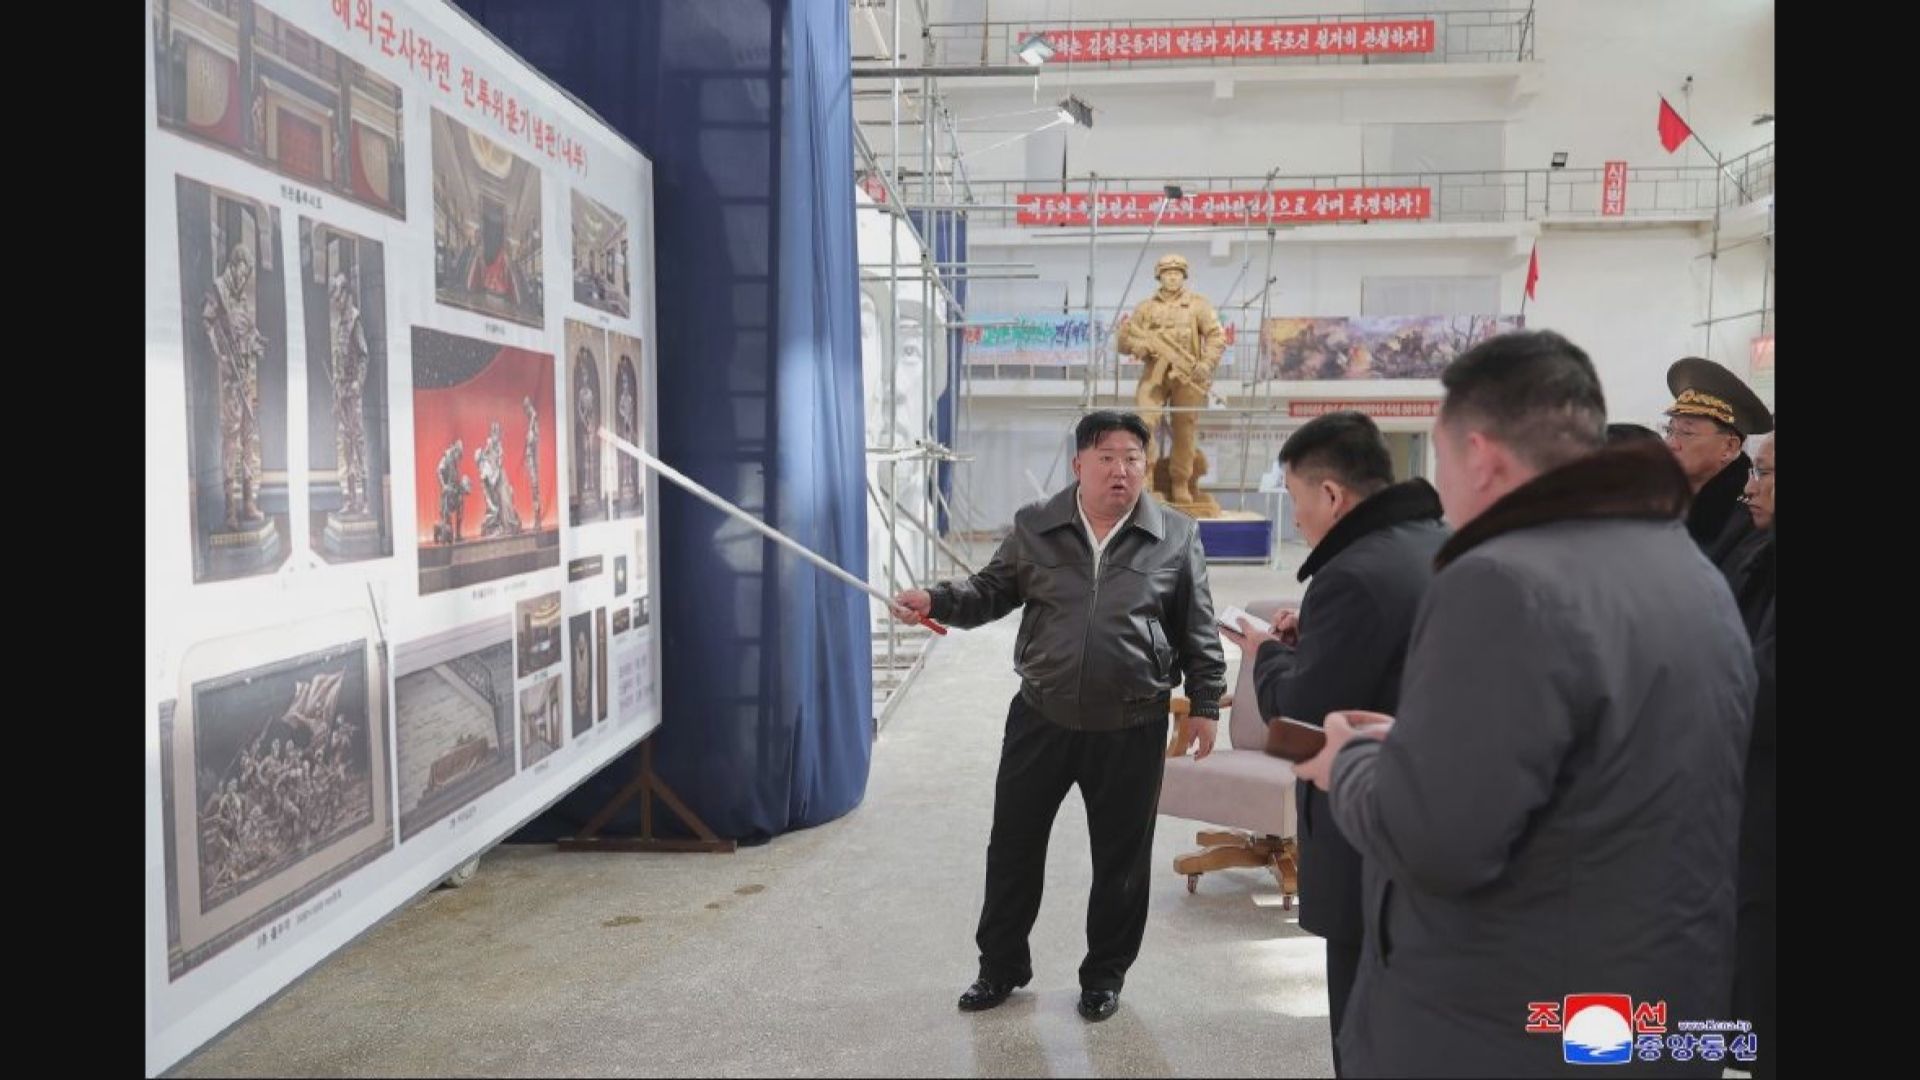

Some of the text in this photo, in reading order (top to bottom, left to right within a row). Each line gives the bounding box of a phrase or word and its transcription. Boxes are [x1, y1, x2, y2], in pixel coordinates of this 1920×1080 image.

[332, 0, 451, 93] 해외군사작전
[1088, 31, 1171, 55] 김정은동지의
[1176, 30, 1219, 53] 말씀과
[1223, 29, 1263, 51] 지시를
[1269, 28, 1310, 50] 무조건
[1314, 26, 1357, 49] 철저히
[1362, 25, 1427, 48] 관철하자!
[1312, 193, 1344, 215] 살며
[1350, 192, 1422, 214] 투쟁하자!
